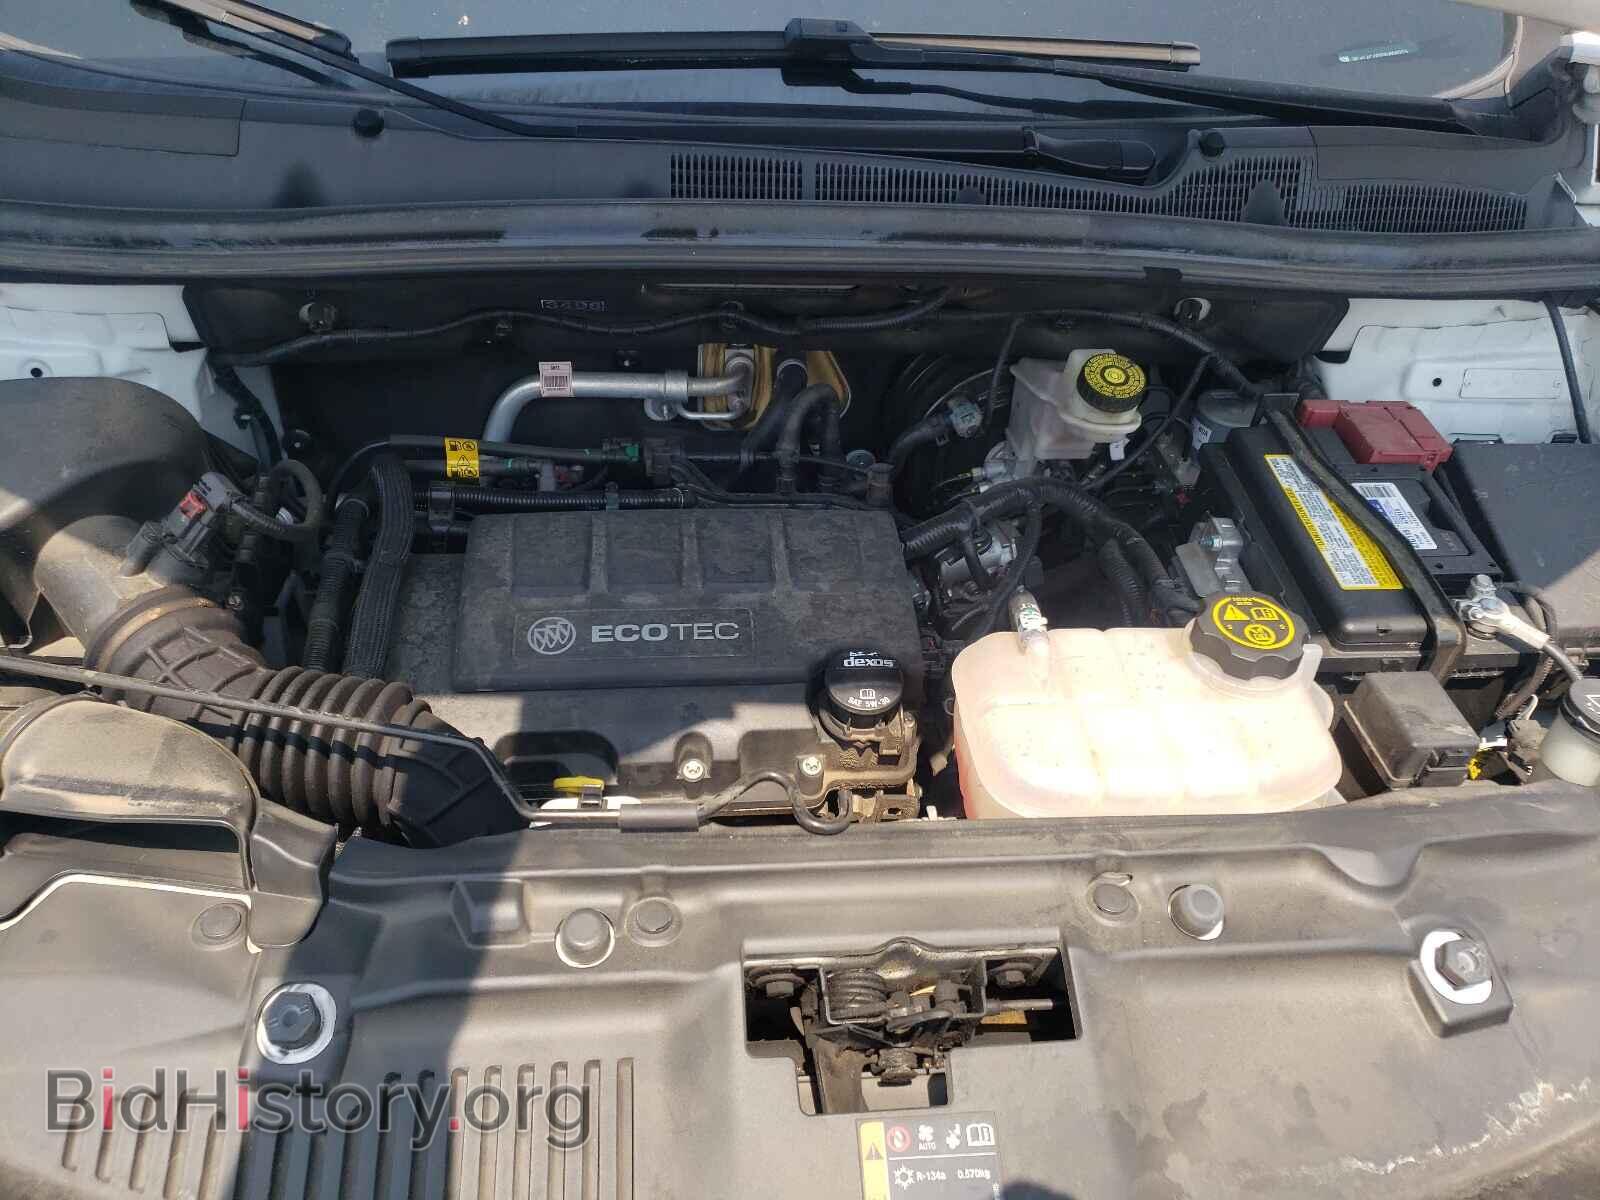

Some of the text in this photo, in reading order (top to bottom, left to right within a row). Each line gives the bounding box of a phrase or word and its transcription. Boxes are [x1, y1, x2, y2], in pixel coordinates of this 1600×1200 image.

[591, 623, 740, 643] ECOTEC
[843, 656, 894, 667] dexos
[918, 1141, 937, 1151] AUTO
